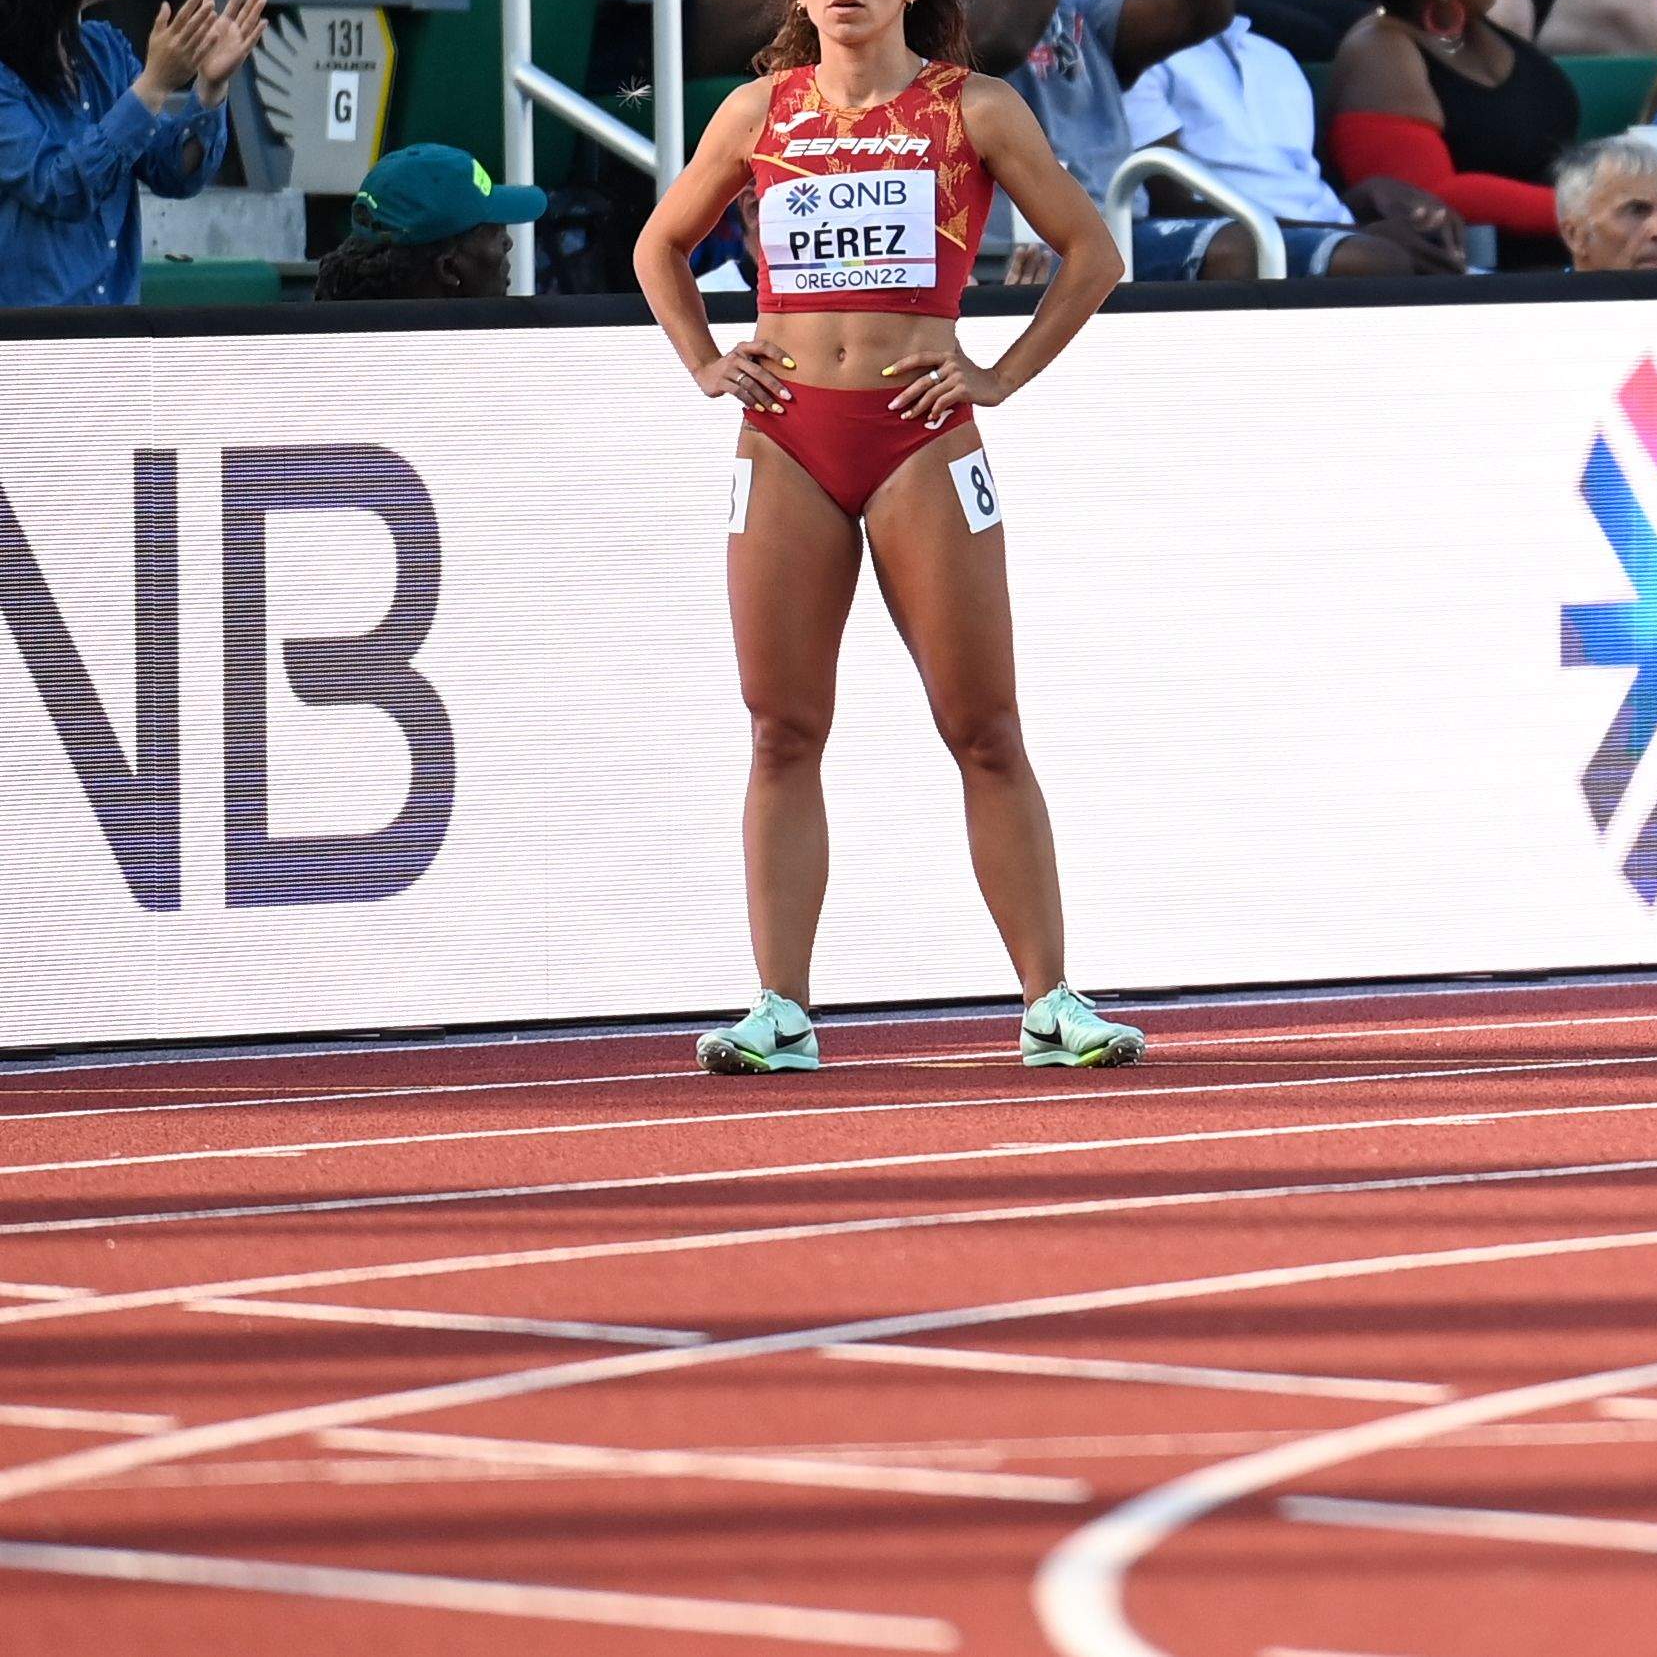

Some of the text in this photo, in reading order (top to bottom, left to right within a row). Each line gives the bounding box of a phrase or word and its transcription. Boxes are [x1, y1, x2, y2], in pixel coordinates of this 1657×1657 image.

[327, 19, 363, 57] 131
[334, 90, 352, 123] G
[783, 134, 932, 158] ESPAÑA
[828, 180, 908, 210] QNB
[788, 222, 907, 261] PÉREZ
[795, 268, 907, 289] OREGON22
[970, 464, 995, 516] 8
